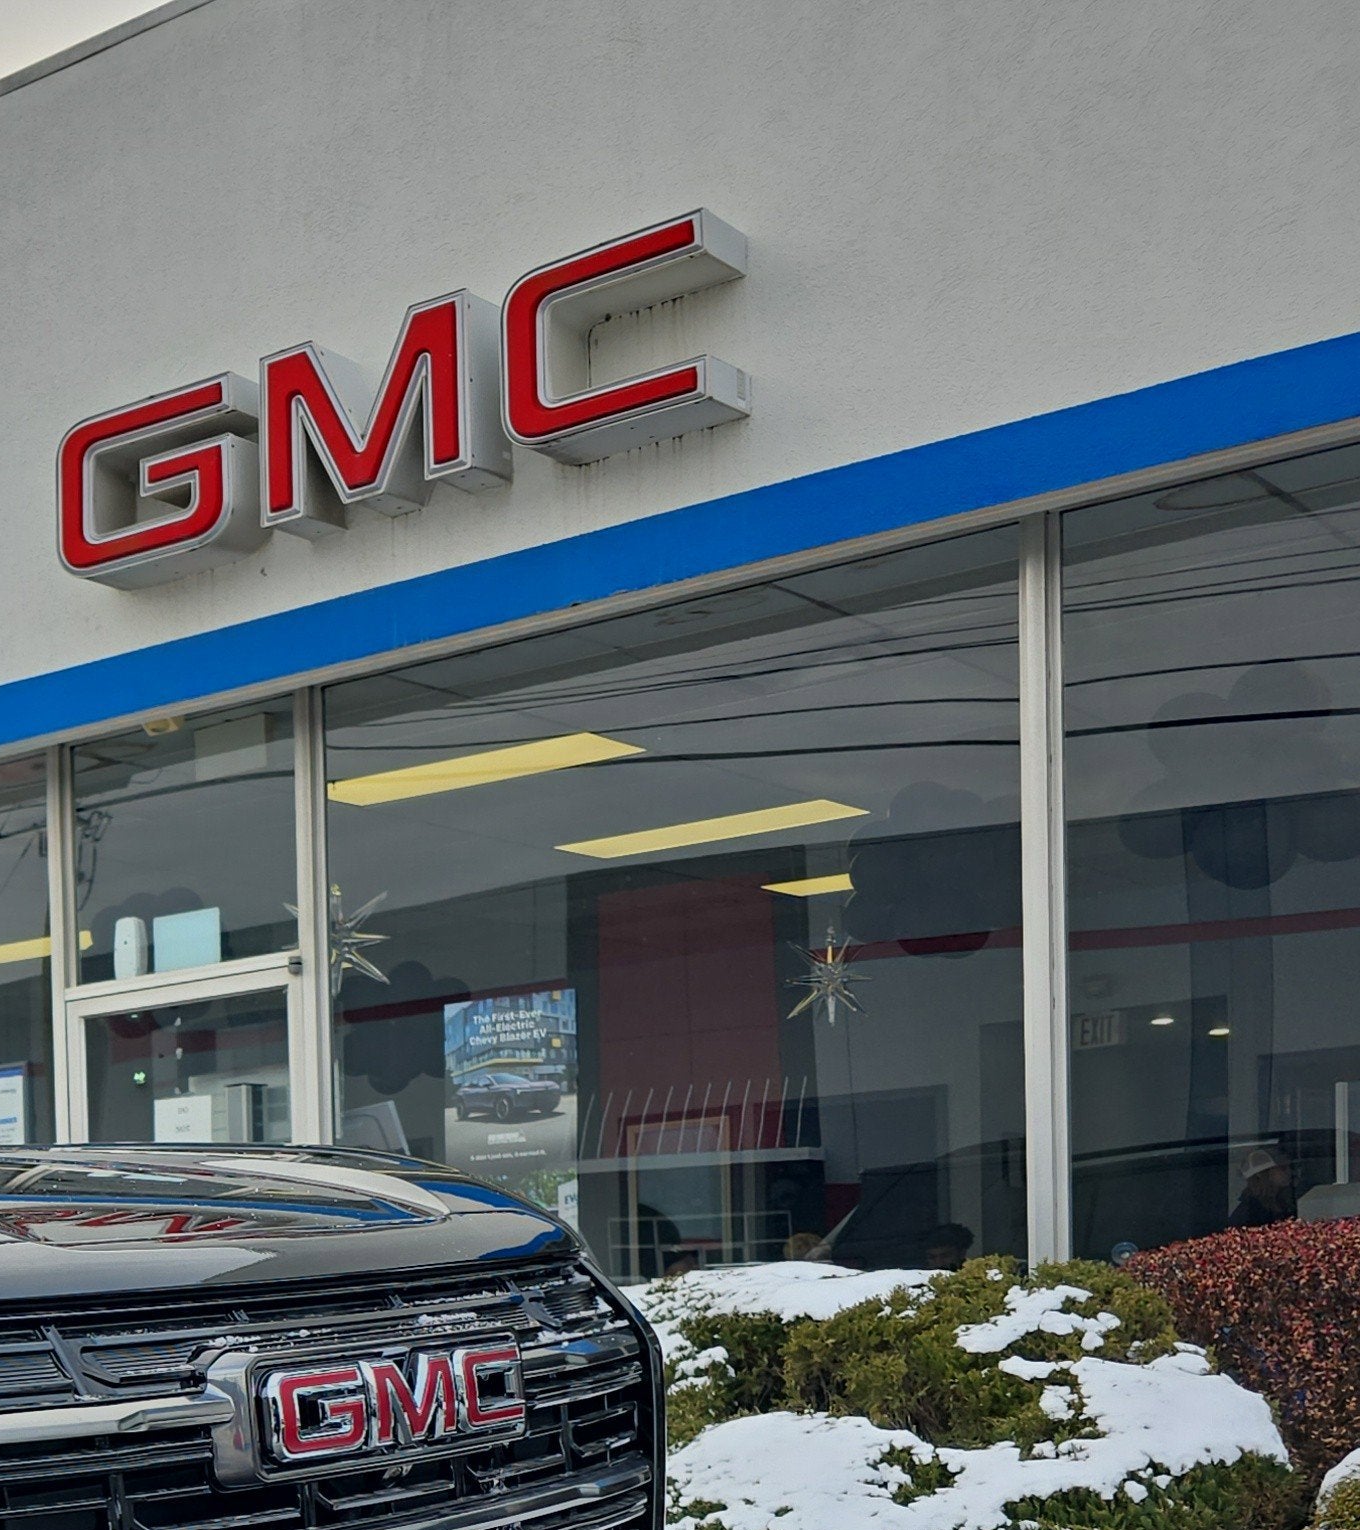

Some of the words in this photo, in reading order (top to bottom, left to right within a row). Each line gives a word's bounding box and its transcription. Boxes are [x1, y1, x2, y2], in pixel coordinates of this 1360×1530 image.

[57, 208, 718, 580] GMC
[473, 1015, 490, 1025] The
[492, 1010, 542, 1021] First-Ever
[480, 1020, 535, 1034] All-Electric
[1081, 1014, 1114, 1046] EXIT
[469, 1034, 498, 1047] Chevy
[499, 1030, 531, 1043] Blazer
[533, 1028, 547, 1039] EV
[264, 1345, 527, 1459] GMC
